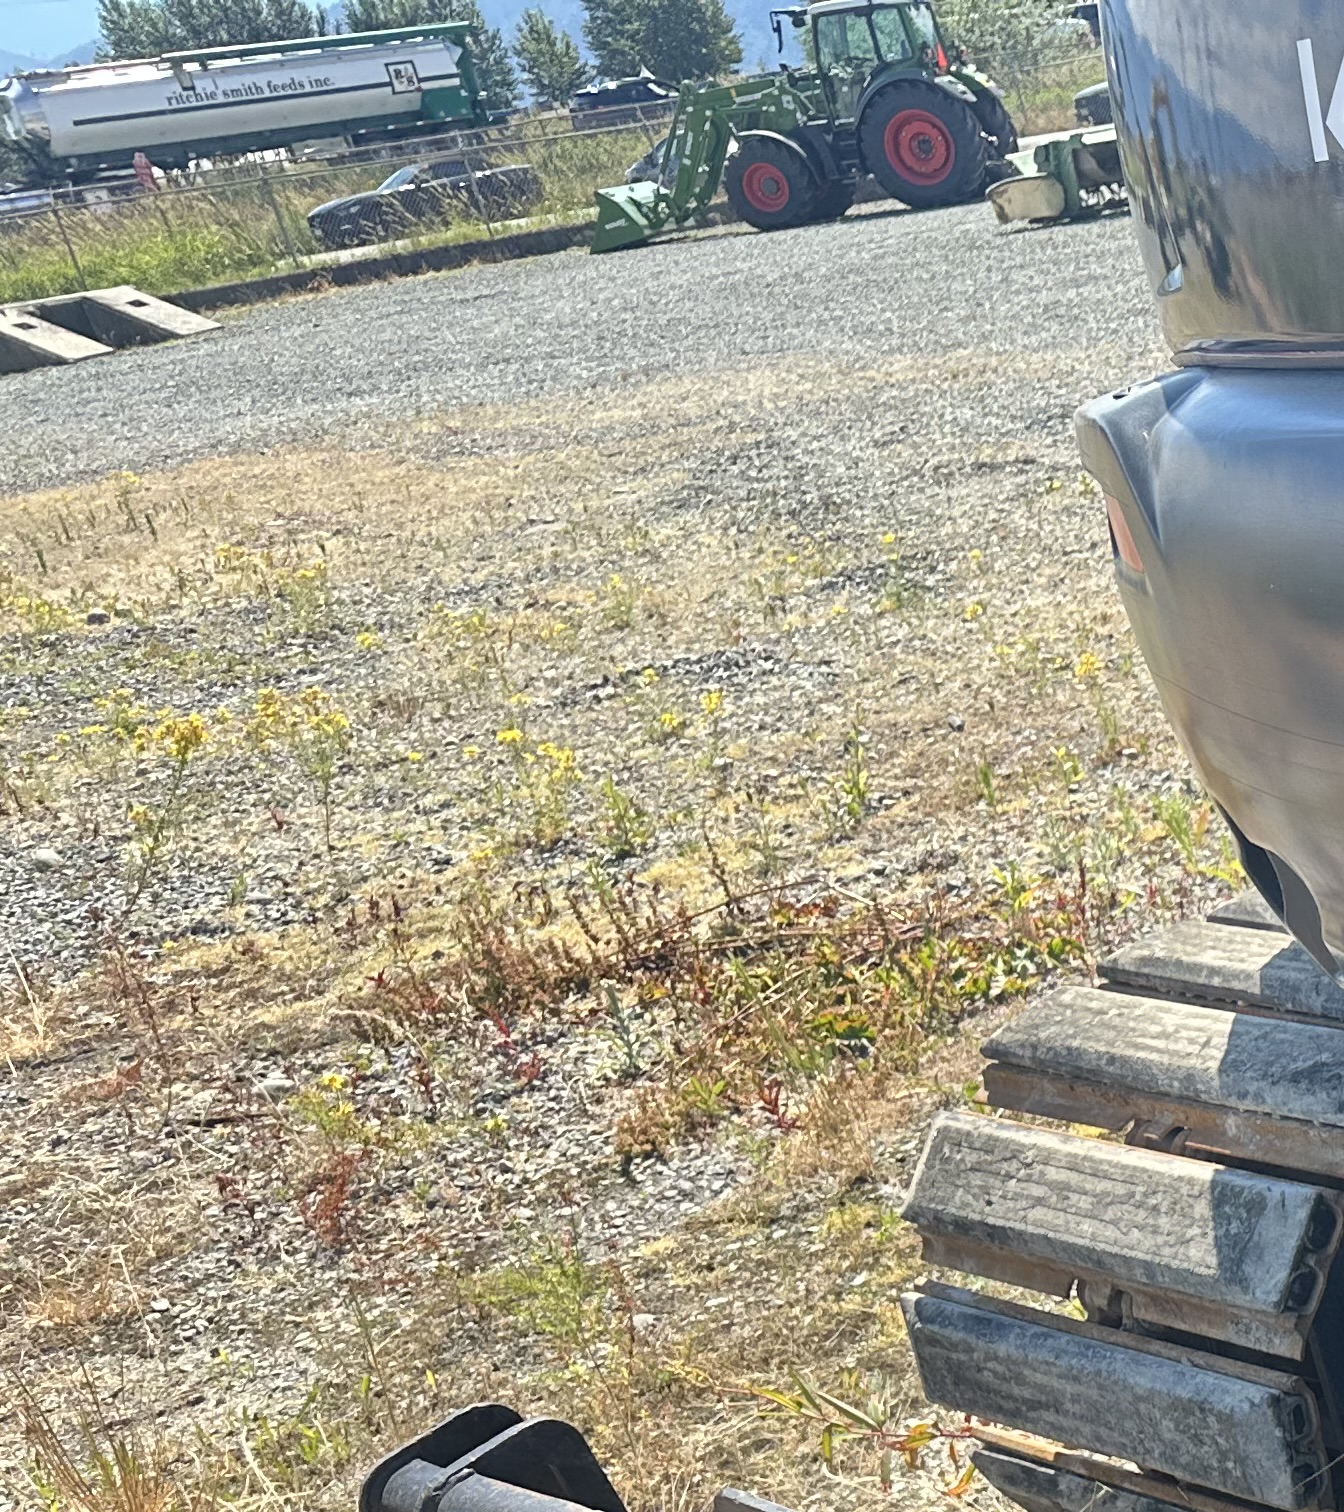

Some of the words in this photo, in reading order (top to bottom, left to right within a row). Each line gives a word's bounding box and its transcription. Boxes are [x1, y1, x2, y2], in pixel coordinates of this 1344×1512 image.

[166, 88, 218, 106] ritchie
[222, 83, 265, 100] smith
[267, 77, 306, 95] feeds
[307, 75, 336, 89] inc.
